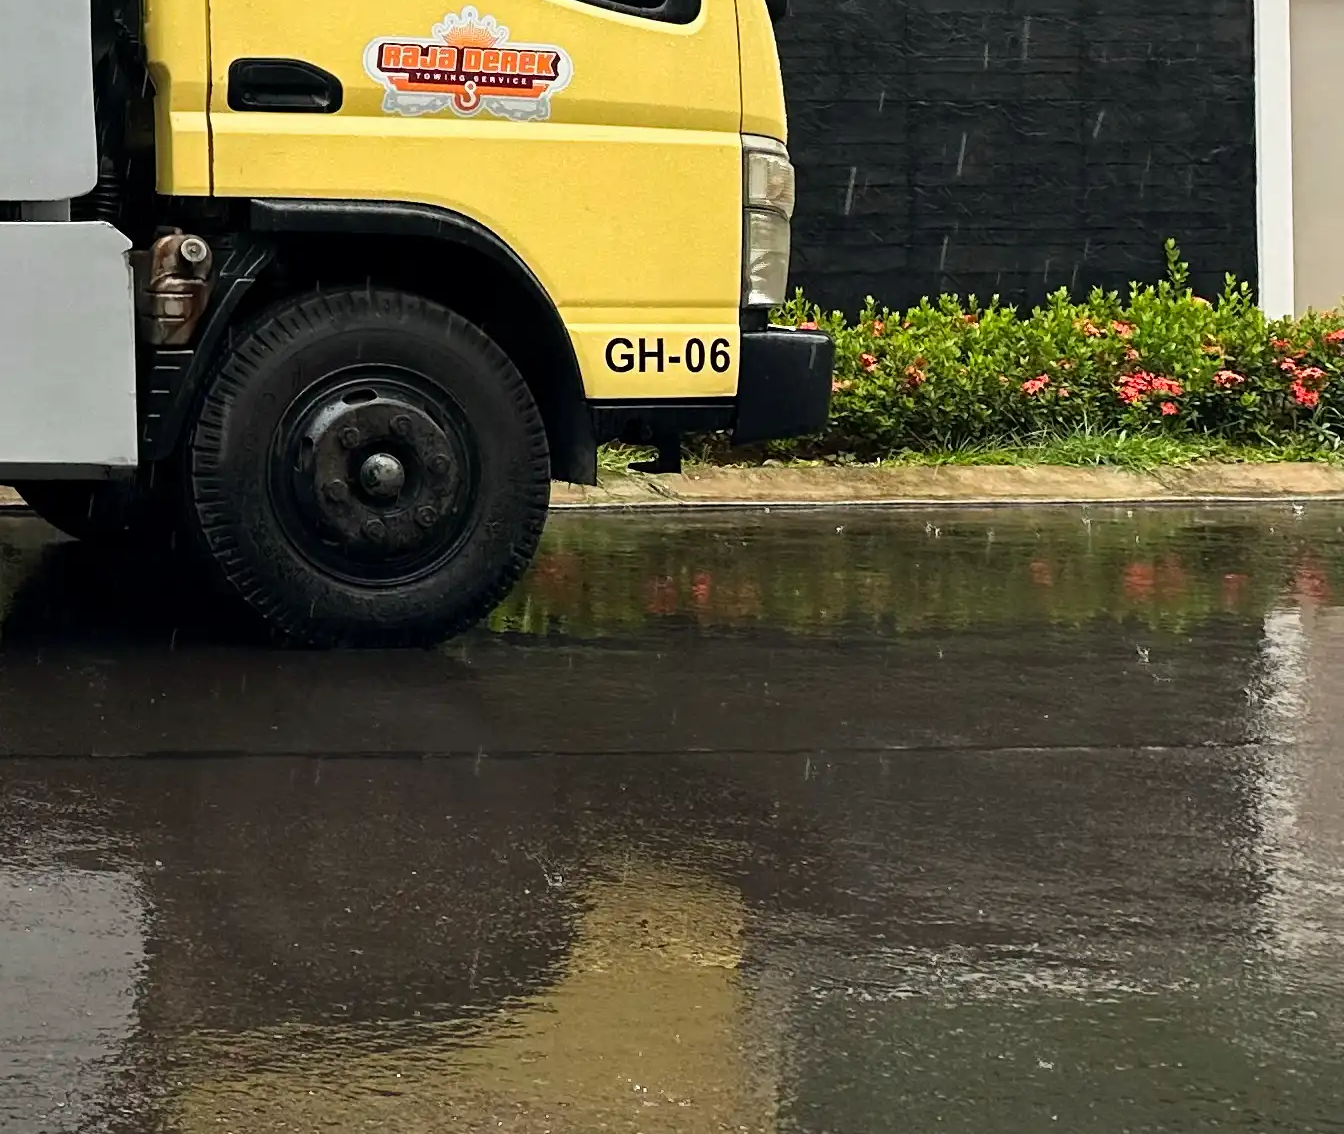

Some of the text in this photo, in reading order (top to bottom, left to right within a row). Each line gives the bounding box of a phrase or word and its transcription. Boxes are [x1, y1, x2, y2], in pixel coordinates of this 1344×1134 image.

[415, 72, 527, 85] TOWING SERVICE
[605, 337, 731, 373] GH-06
